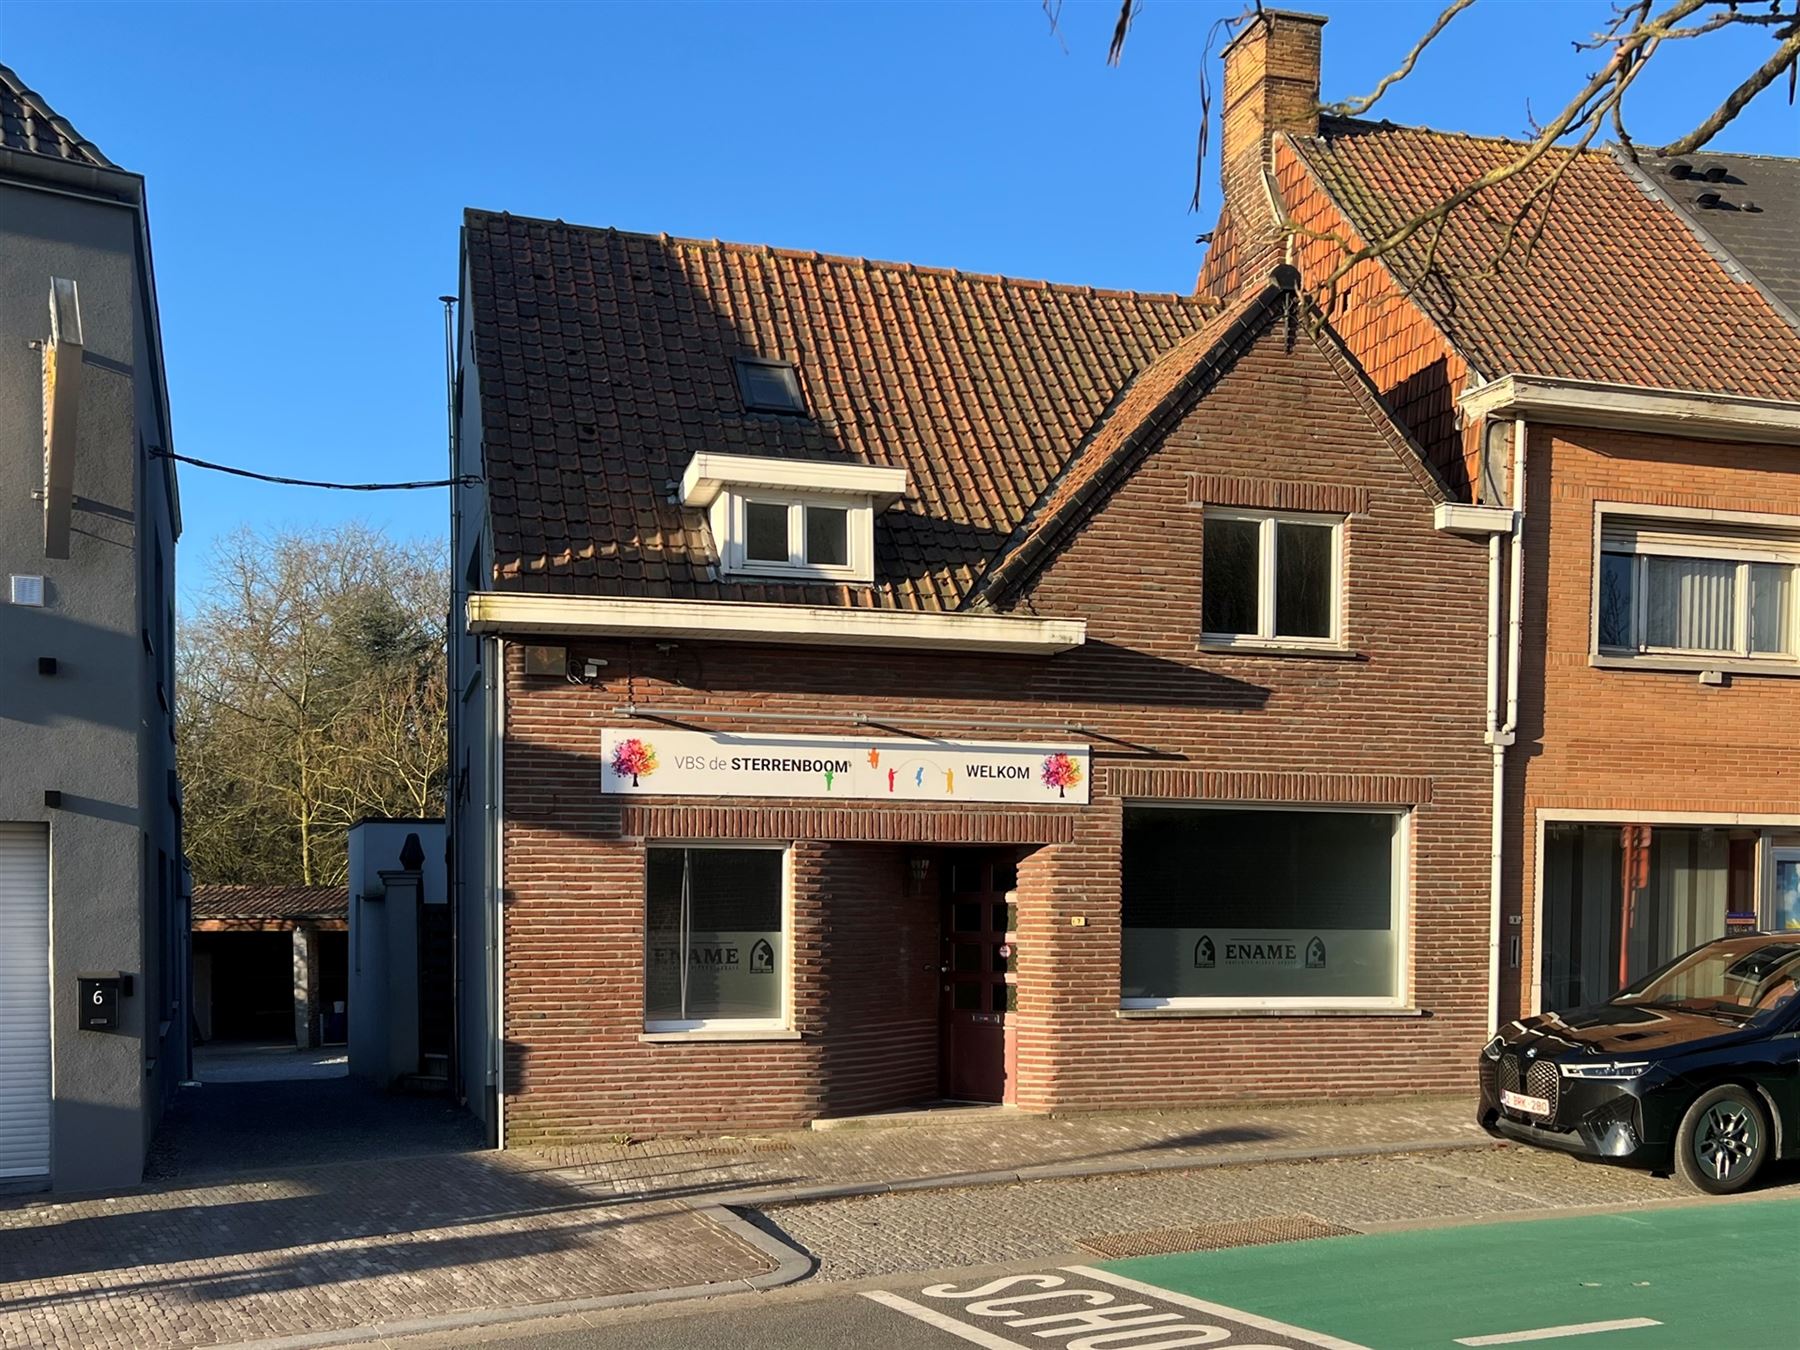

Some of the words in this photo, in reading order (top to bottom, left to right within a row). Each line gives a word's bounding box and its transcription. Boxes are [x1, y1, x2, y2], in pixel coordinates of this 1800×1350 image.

[675, 756, 705, 770] VBS
[709, 757, 727, 771] de
[731, 757, 848, 773] STERRENBOOM
[966, 764, 1030, 780] WELKOM
[1225, 944, 1297, 960] ENAME
[93, 990, 103, 1005] 6
